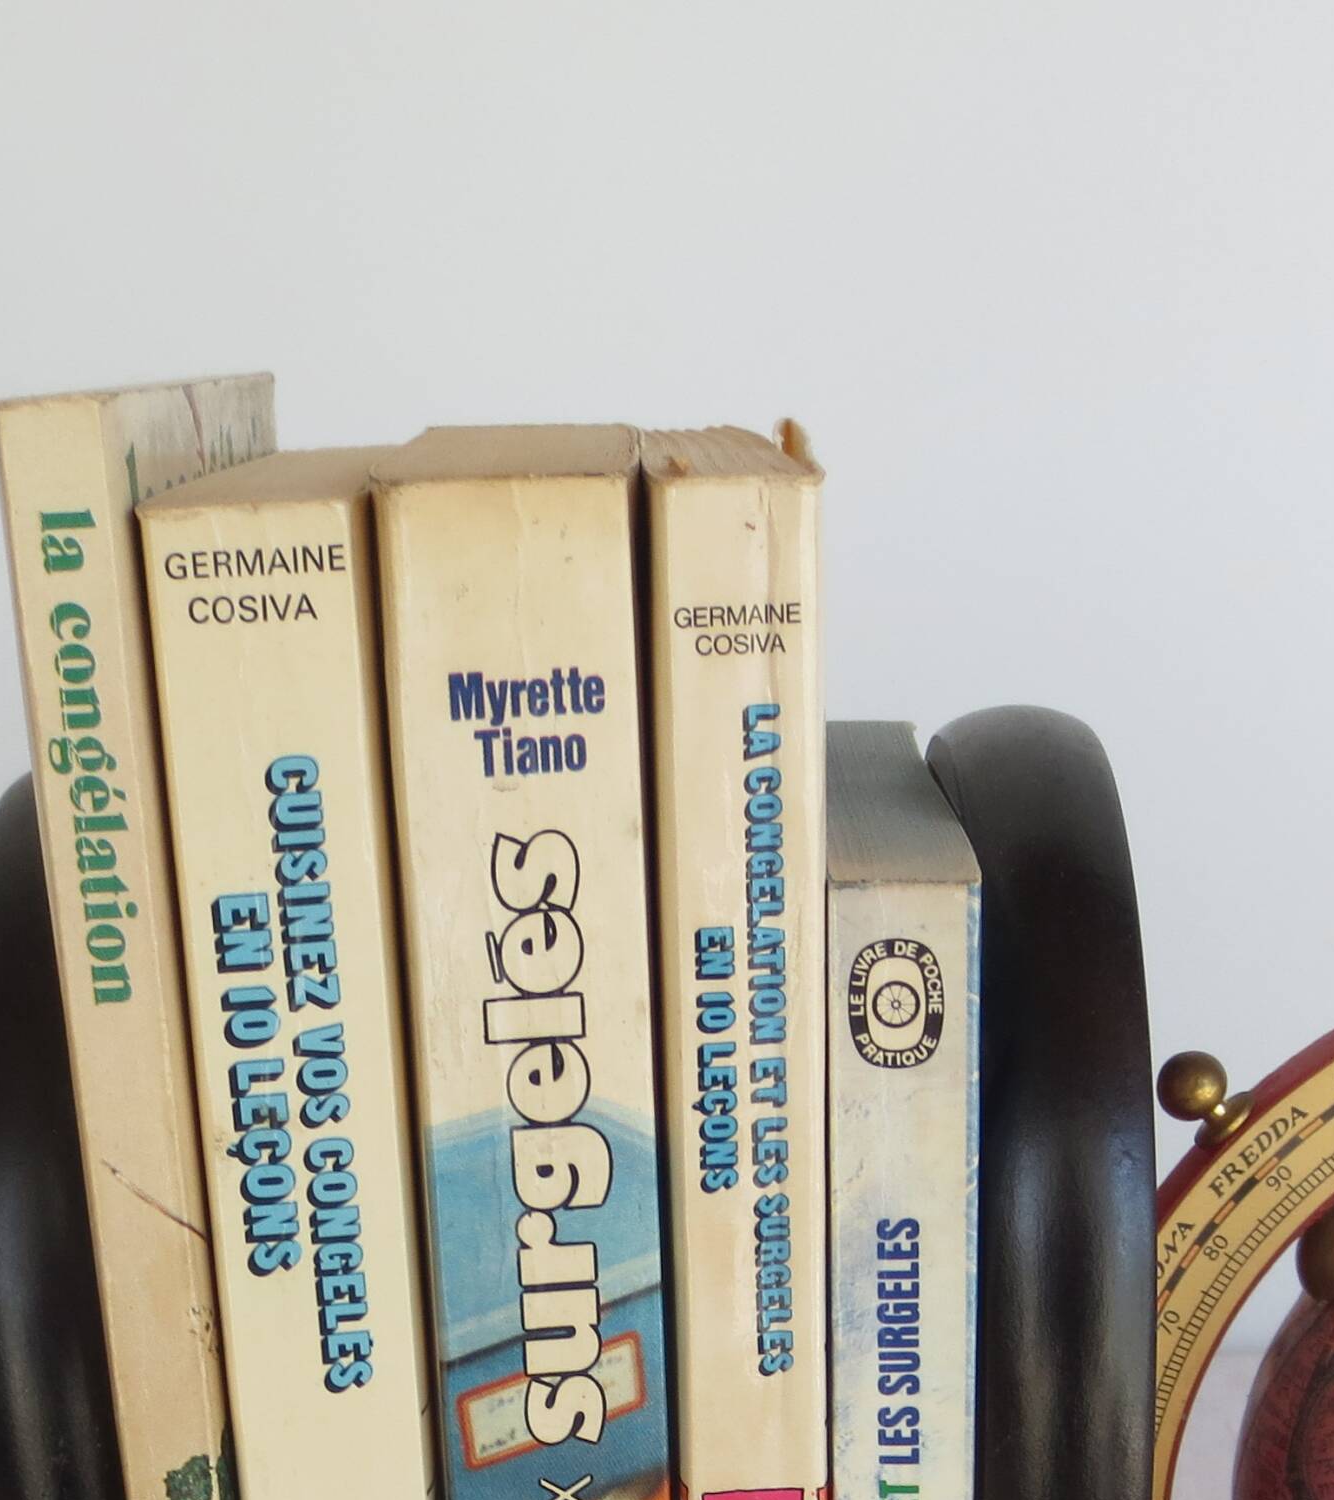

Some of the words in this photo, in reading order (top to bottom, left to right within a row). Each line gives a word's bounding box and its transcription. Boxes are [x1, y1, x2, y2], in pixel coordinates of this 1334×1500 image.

[40, 507, 97, 575] la
[164, 542, 346, 580] GERMAINE
[186, 594, 318, 625] COSIVA
[674, 603, 802, 629] GERMAINE
[695, 632, 786, 656] COSIVA
[448, 667, 606, 727] Myrette
[474, 728, 586, 777] Tiano
[743, 703, 781, 761] LA
[47, 600, 138, 1005] congélation
[265, 755, 341, 1012] CUISINEZ
[211, 892, 274, 973] EN
[695, 925, 735, 980] EN
[894, 941, 919, 957] DE
[852, 942, 888, 986] LIVRE
[919, 953, 942, 1015] POCHE
[220, 985, 281, 1048] 10
[696, 991, 737, 1034] 10
[851, 994, 864, 1016] LE
[293, 1022, 351, 1128] VOS
[855, 1033, 937, 1067] PRATIQUE
[750, 1057, 787, 1108] ET
[483, 829, 613, 1445] surgelés
[692, 1041, 739, 1193] LEÇONS
[226, 1059, 302, 1277] LEÇONS
[751, 1116, 788, 1189] LES
[1208, 1105, 1308, 1198] FREDDA
[1158, 1309, 1181, 1336] 70
[1203, 1234, 1228, 1261] 80
[1265, 1165, 1292, 1192] 90
[877, 1217, 919, 1396] SURGELES
[878, 1406, 919, 1464] LES
